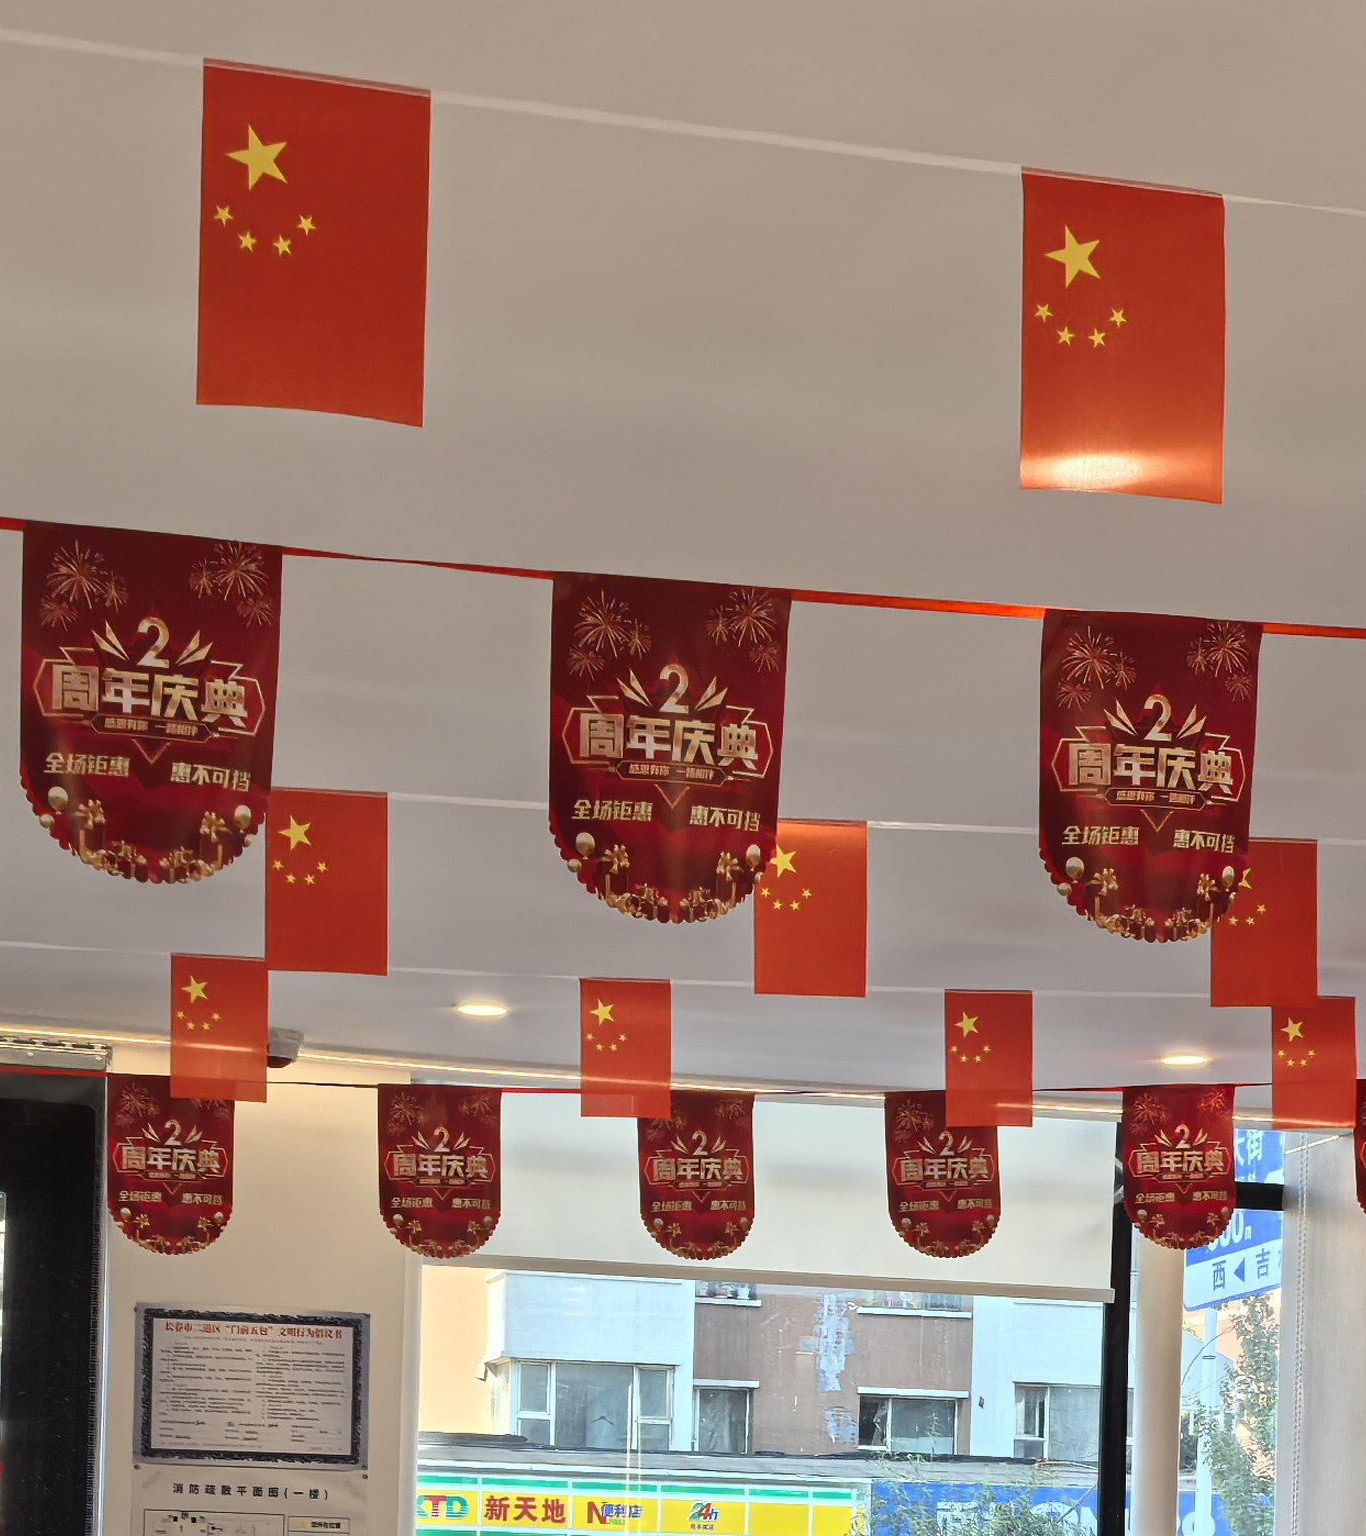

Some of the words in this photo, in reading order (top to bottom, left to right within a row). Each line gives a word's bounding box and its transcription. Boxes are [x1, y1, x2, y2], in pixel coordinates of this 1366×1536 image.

[136, 617, 170, 669] 2
[52, 664, 248, 729] 周年庆典
[659, 664, 689, 714] 2
[1144, 693, 1172, 742] 2
[579, 713, 759, 771] 周年庆典
[1068, 743, 1234, 795] 周年庆典
[164, 1119, 183, 1147] 2
[434, 1127, 450, 1153] 2
[692, 1130, 708, 1156] 2
[939, 1131, 955, 1156] 2
[1174, 1124, 1191, 1149] 2
[121, 1145, 221, 1173] 周年庆典
[392, 1153, 489, 1180] 周年庆典
[652, 1156, 745, 1182] 周年庆典
[899, 1157, 988, 1182] 周年庆典
[1137, 1150, 1224, 1173] 周年庆典
[1212, 1260, 1226, 1291] 西
[484, 1495, 566, 1524] 新天地
[602, 1503, 642, 1518] 便利店
[689, 1502, 719, 1522] 24h
